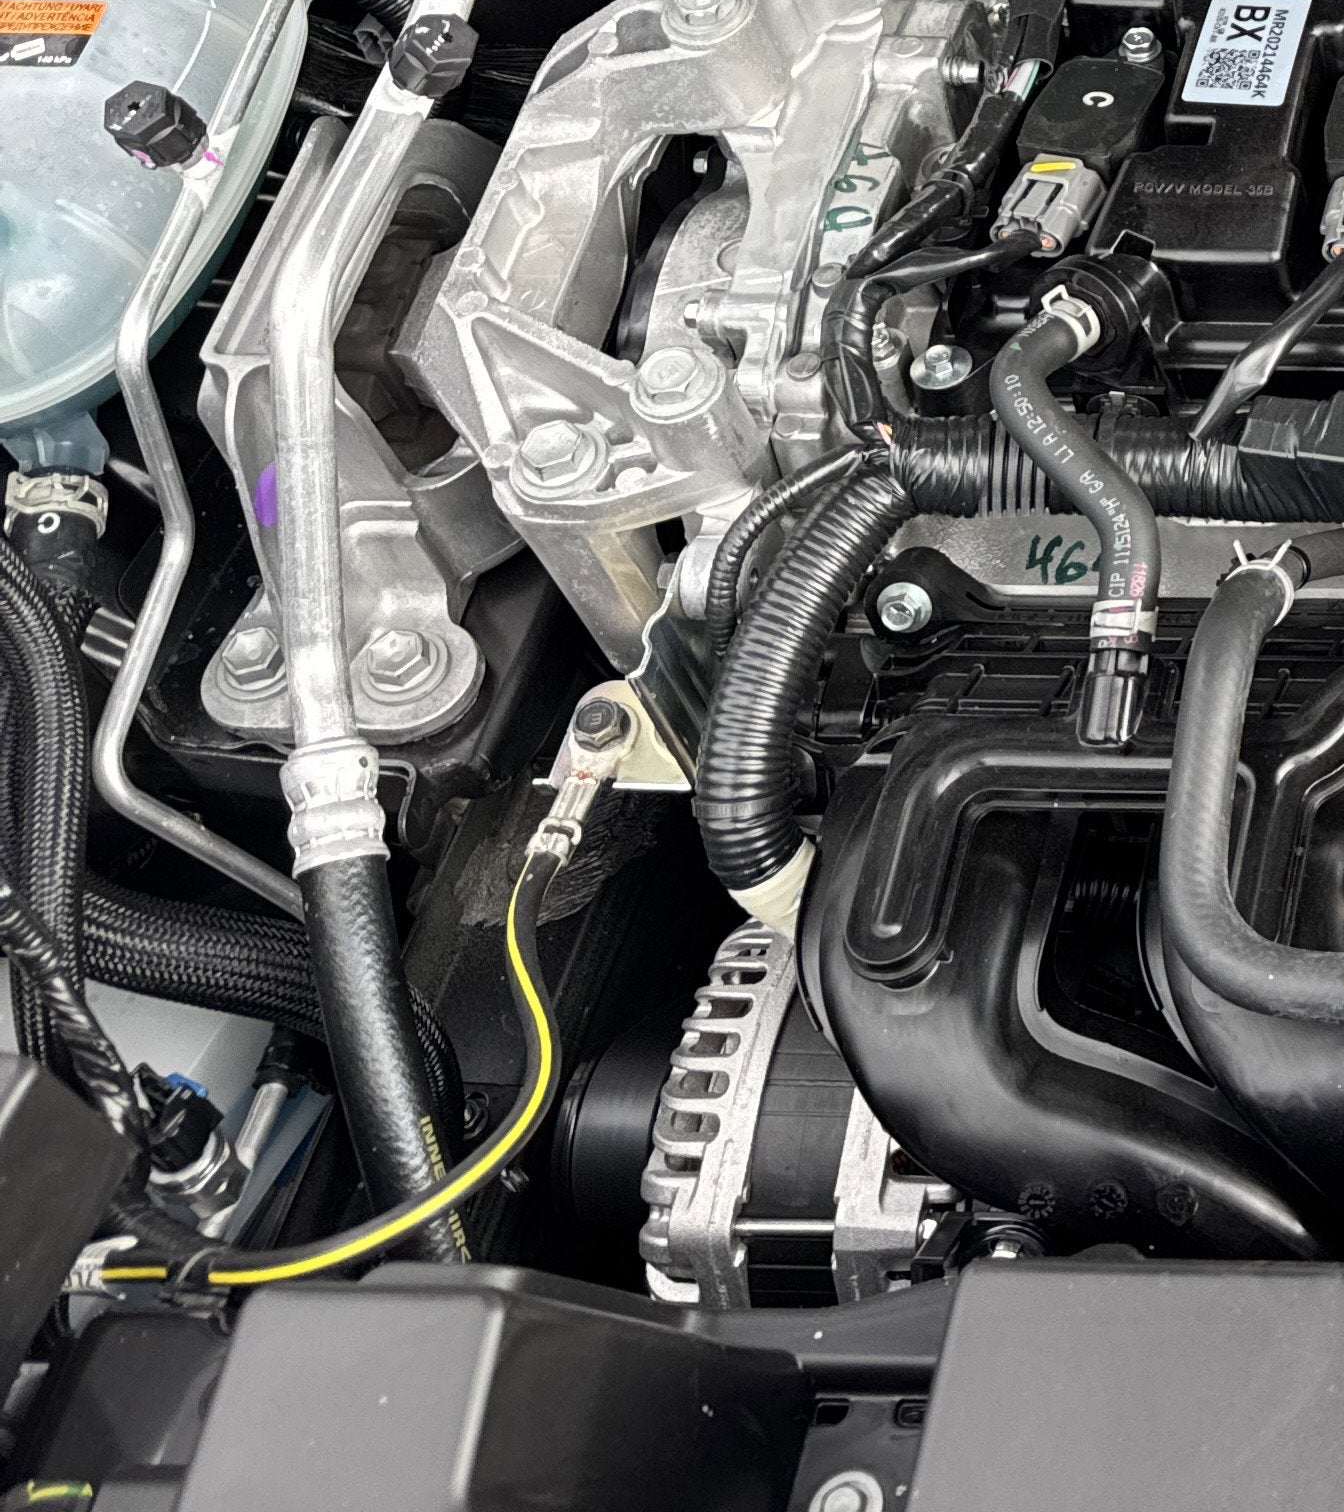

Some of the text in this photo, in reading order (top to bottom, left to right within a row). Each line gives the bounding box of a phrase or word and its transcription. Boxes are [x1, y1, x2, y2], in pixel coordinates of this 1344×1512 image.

[1226, 4, 1272, 42] BX
[1251, 8, 1290, 99] MR20214464K
[1189, 182, 1242, 196] MODEL
[1004, 373, 1048, 435] 12:50:10
[1108, 571, 1126, 598] CIP
